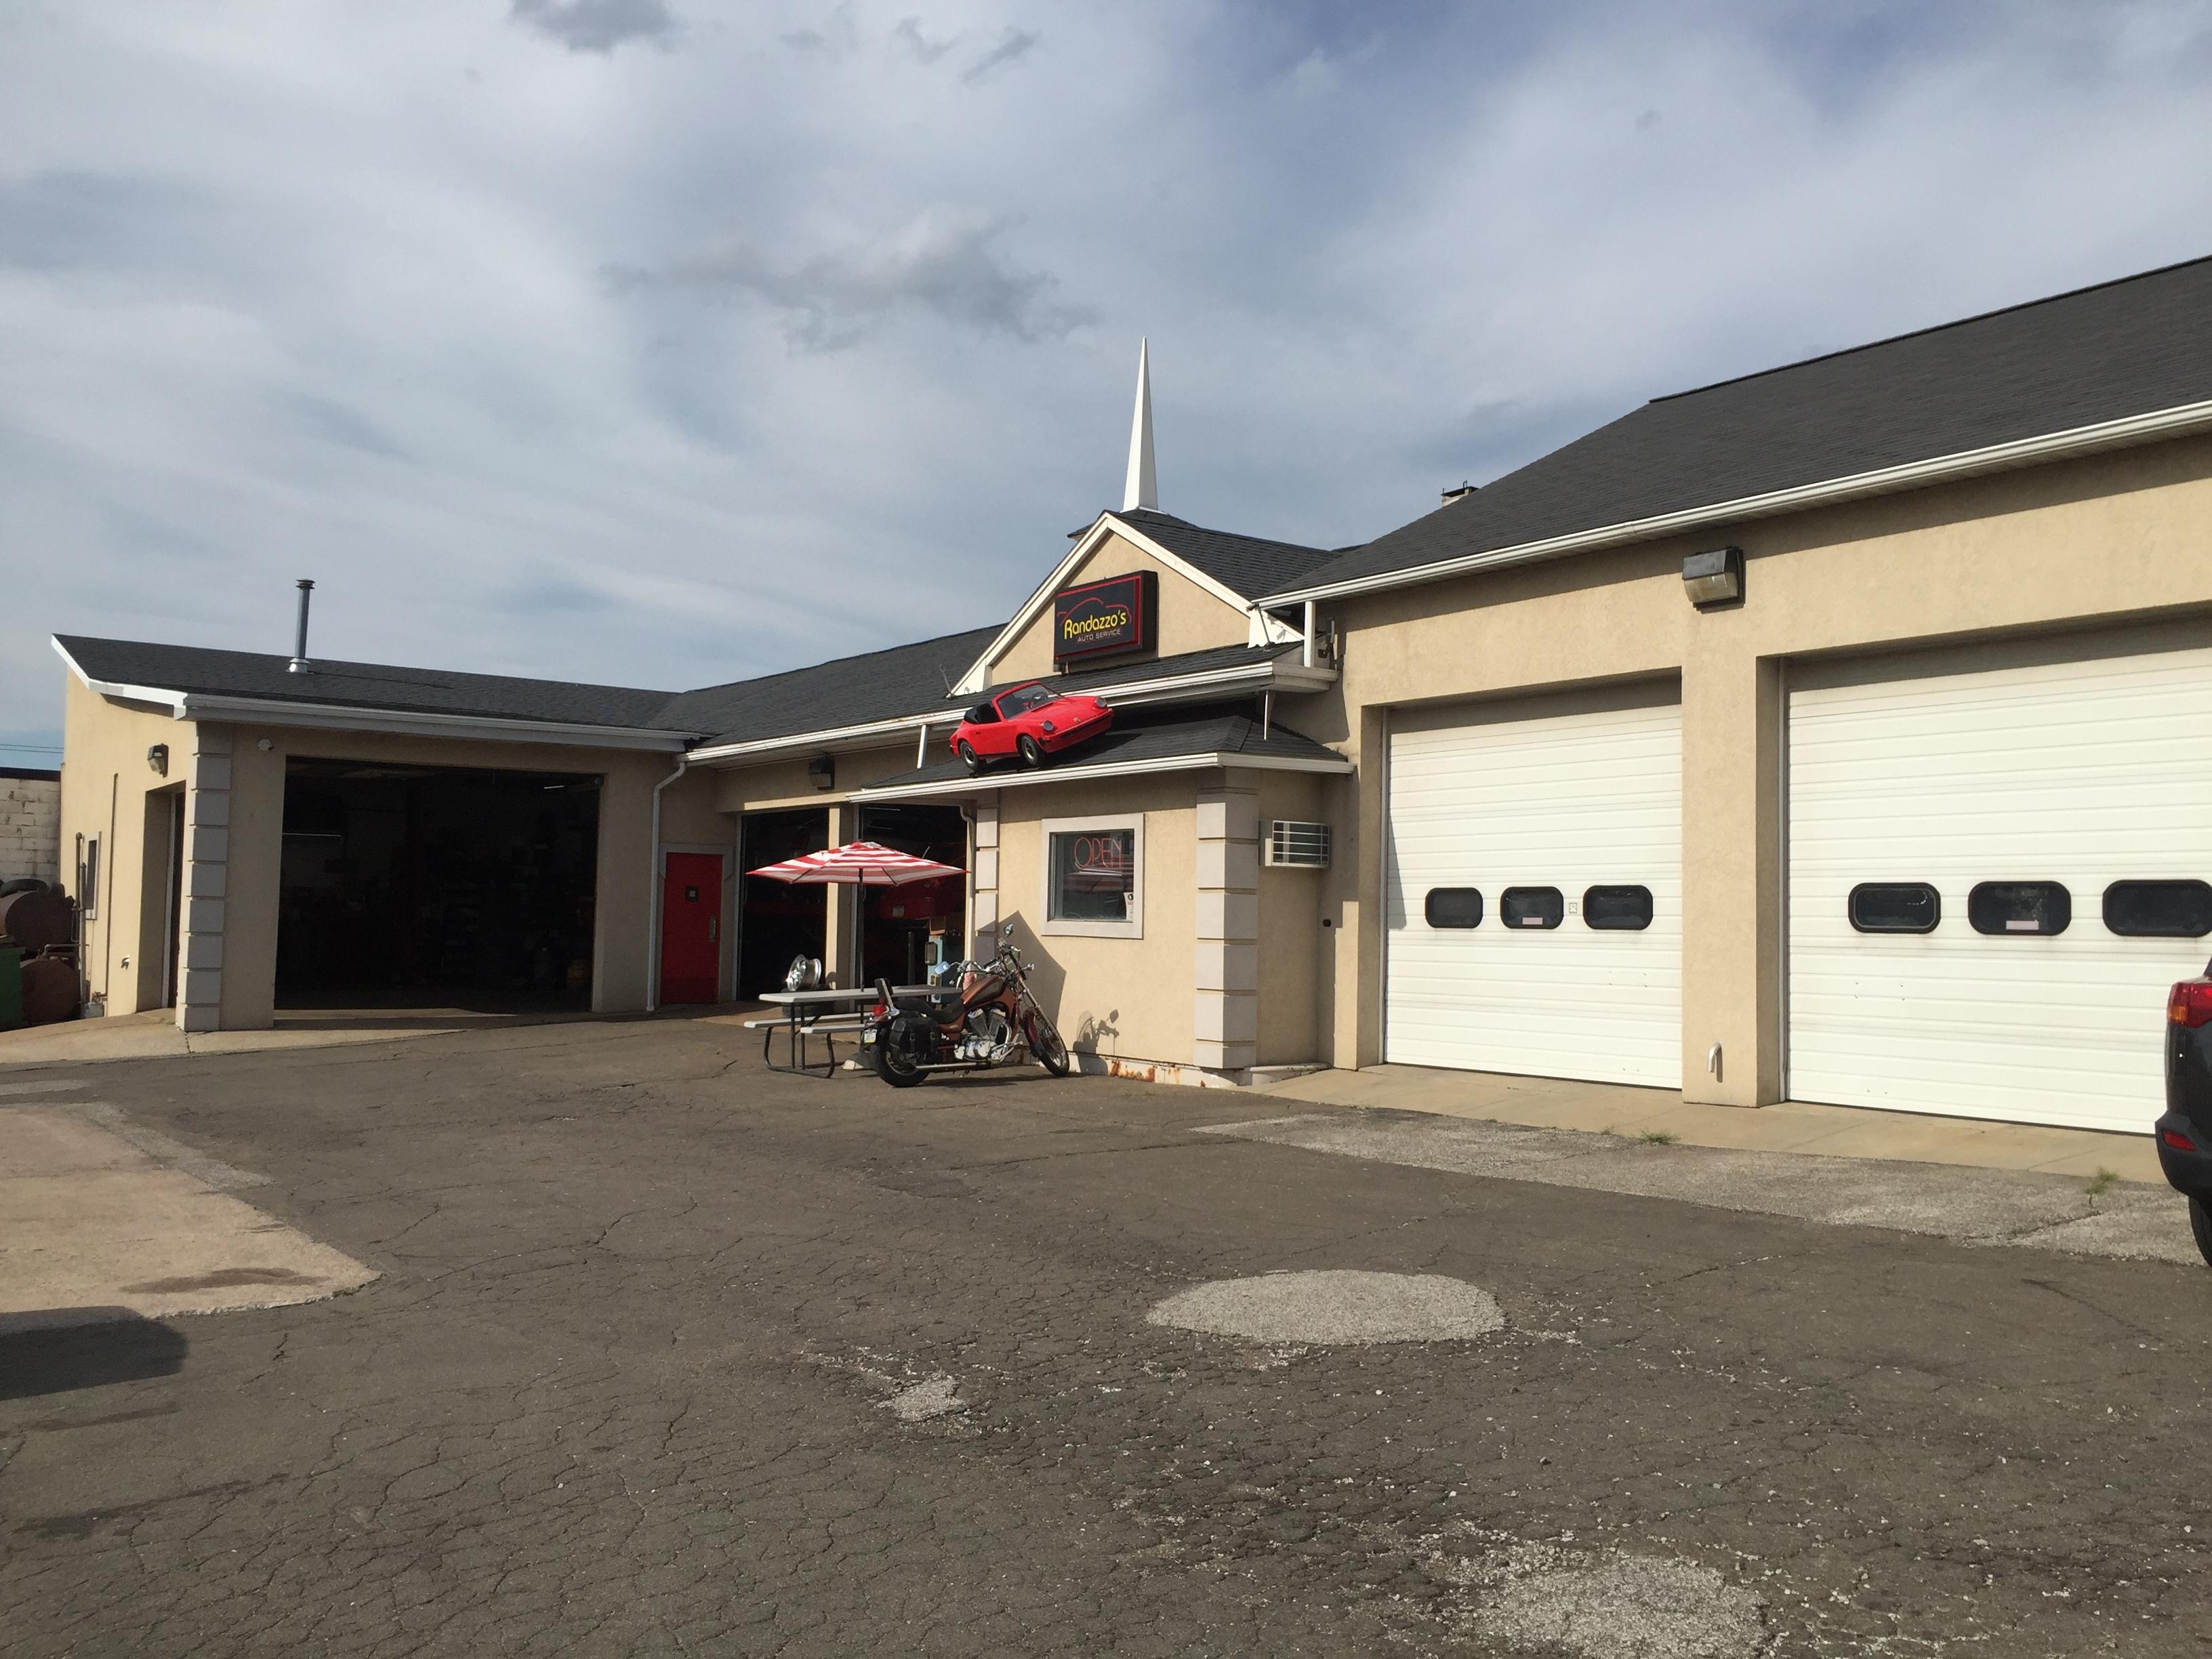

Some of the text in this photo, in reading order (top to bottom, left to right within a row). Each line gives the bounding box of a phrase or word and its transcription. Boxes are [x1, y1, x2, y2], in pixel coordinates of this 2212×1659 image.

[1064, 609, 1126, 640] Randazzo's
[1078, 628, 1121, 642] AUTO SERVICE
[1074, 837, 1122, 868] OPEN
